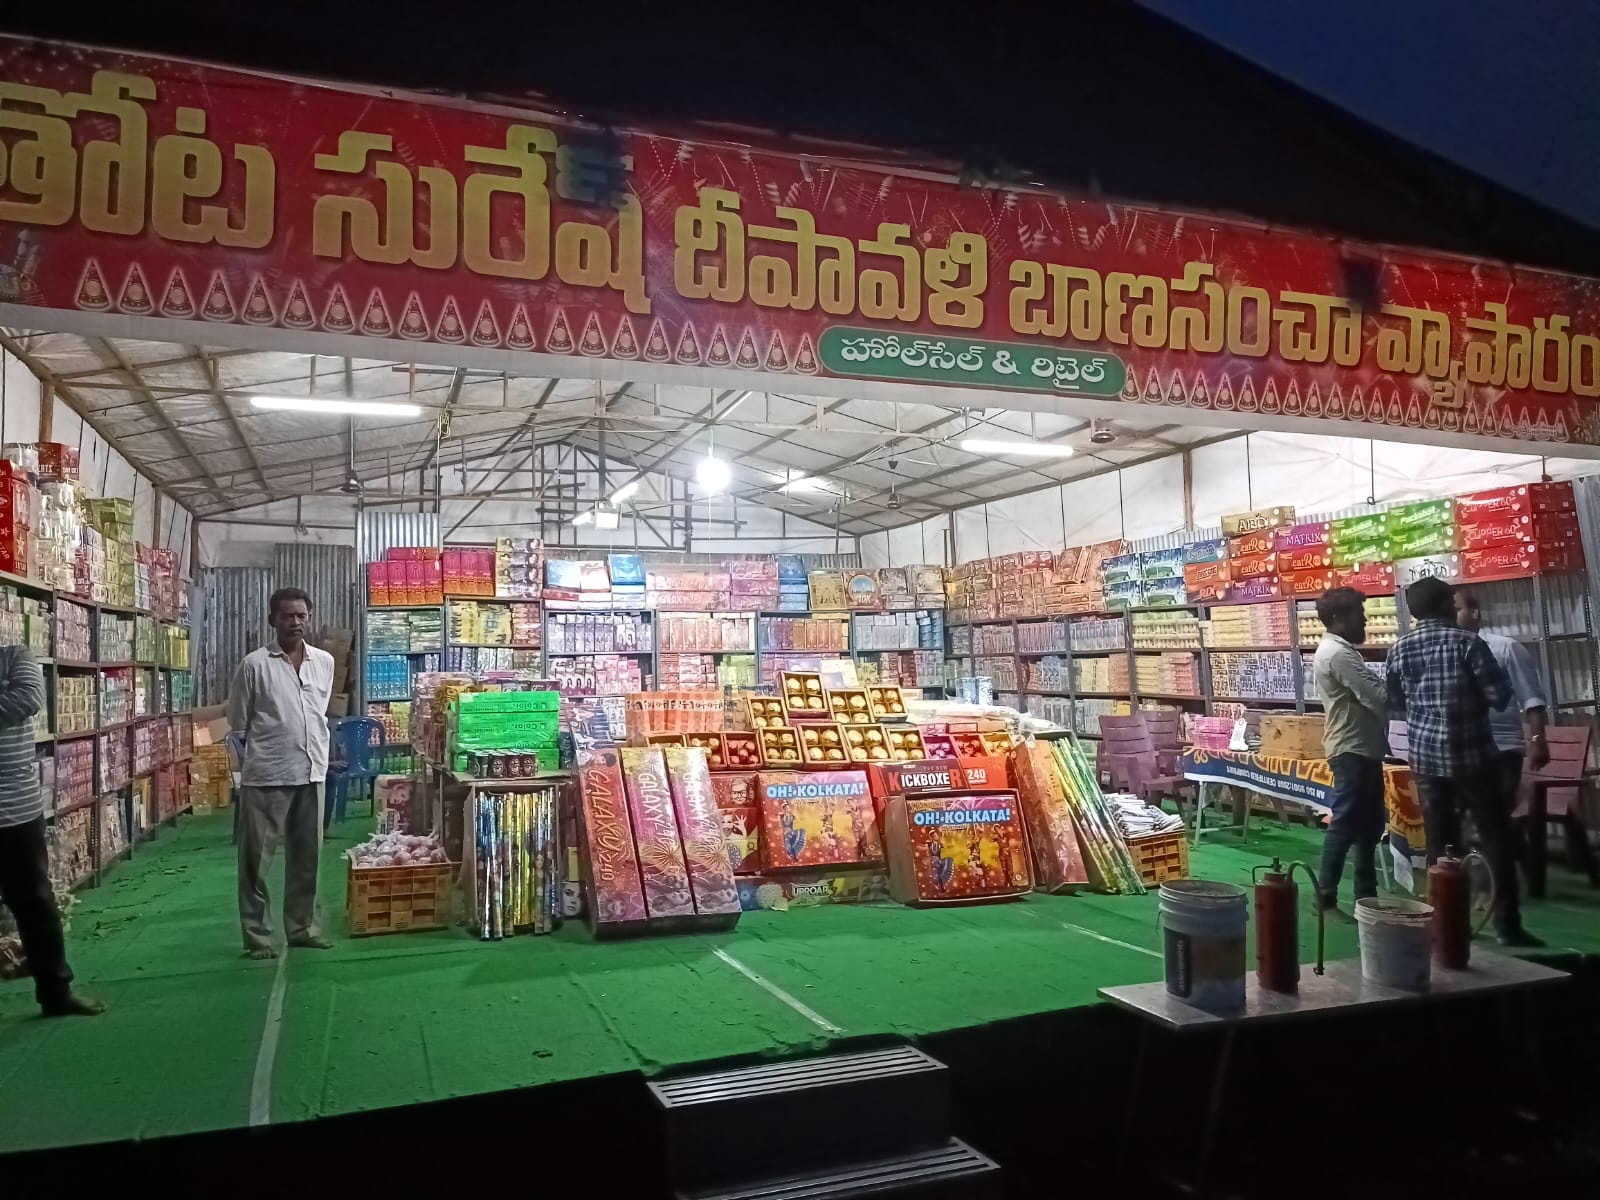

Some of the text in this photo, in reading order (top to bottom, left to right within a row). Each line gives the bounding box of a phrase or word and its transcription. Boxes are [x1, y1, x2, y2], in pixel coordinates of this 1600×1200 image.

[674, 186, 988, 328] దీపావళి
[1009, 259, 1361, 367] బాణసంచా
[992, 351, 1022, 375] &
[1286, 533, 1321, 545] MATRIX
[1241, 584, 1271, 596] MATRIX
[888, 769, 986, 791] KICKBOXER 240
[638, 773, 663, 830] GALAXY
[587, 769, 622, 881] GALAXY 240
[793, 885, 829, 896] UPROAR
